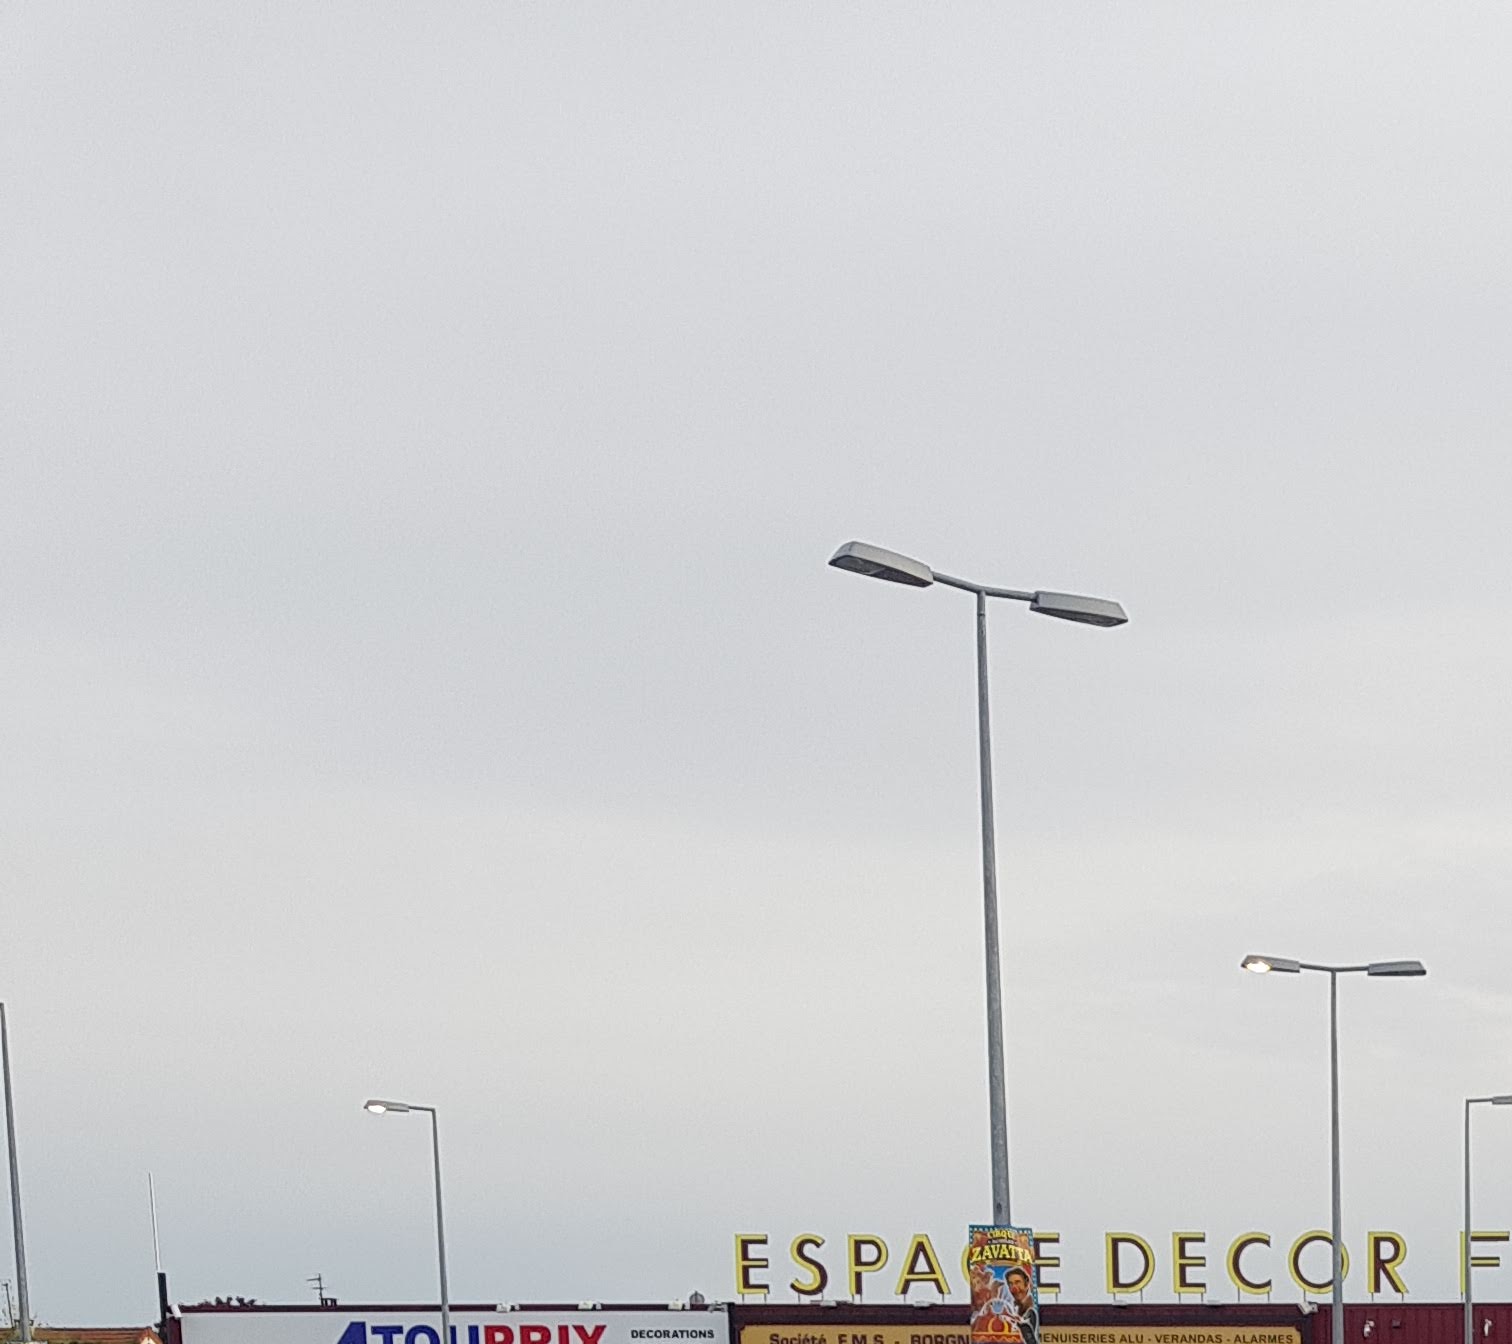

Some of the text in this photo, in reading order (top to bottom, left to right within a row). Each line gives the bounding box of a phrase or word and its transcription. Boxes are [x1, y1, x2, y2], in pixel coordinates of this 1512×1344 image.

[970, 1243, 1034, 1264] ZAVATTA
[734, 1232, 1061, 1295] ESPAE
[1104, 1229, 1410, 1295] DECOR
[630, 1329, 715, 1339] DECORATIONS
[1119, 1333, 1145, 1344] ALU
[1154, 1333, 1223, 1344] VERANDAS
[1232, 1333, 1294, 1344] ALARMES
